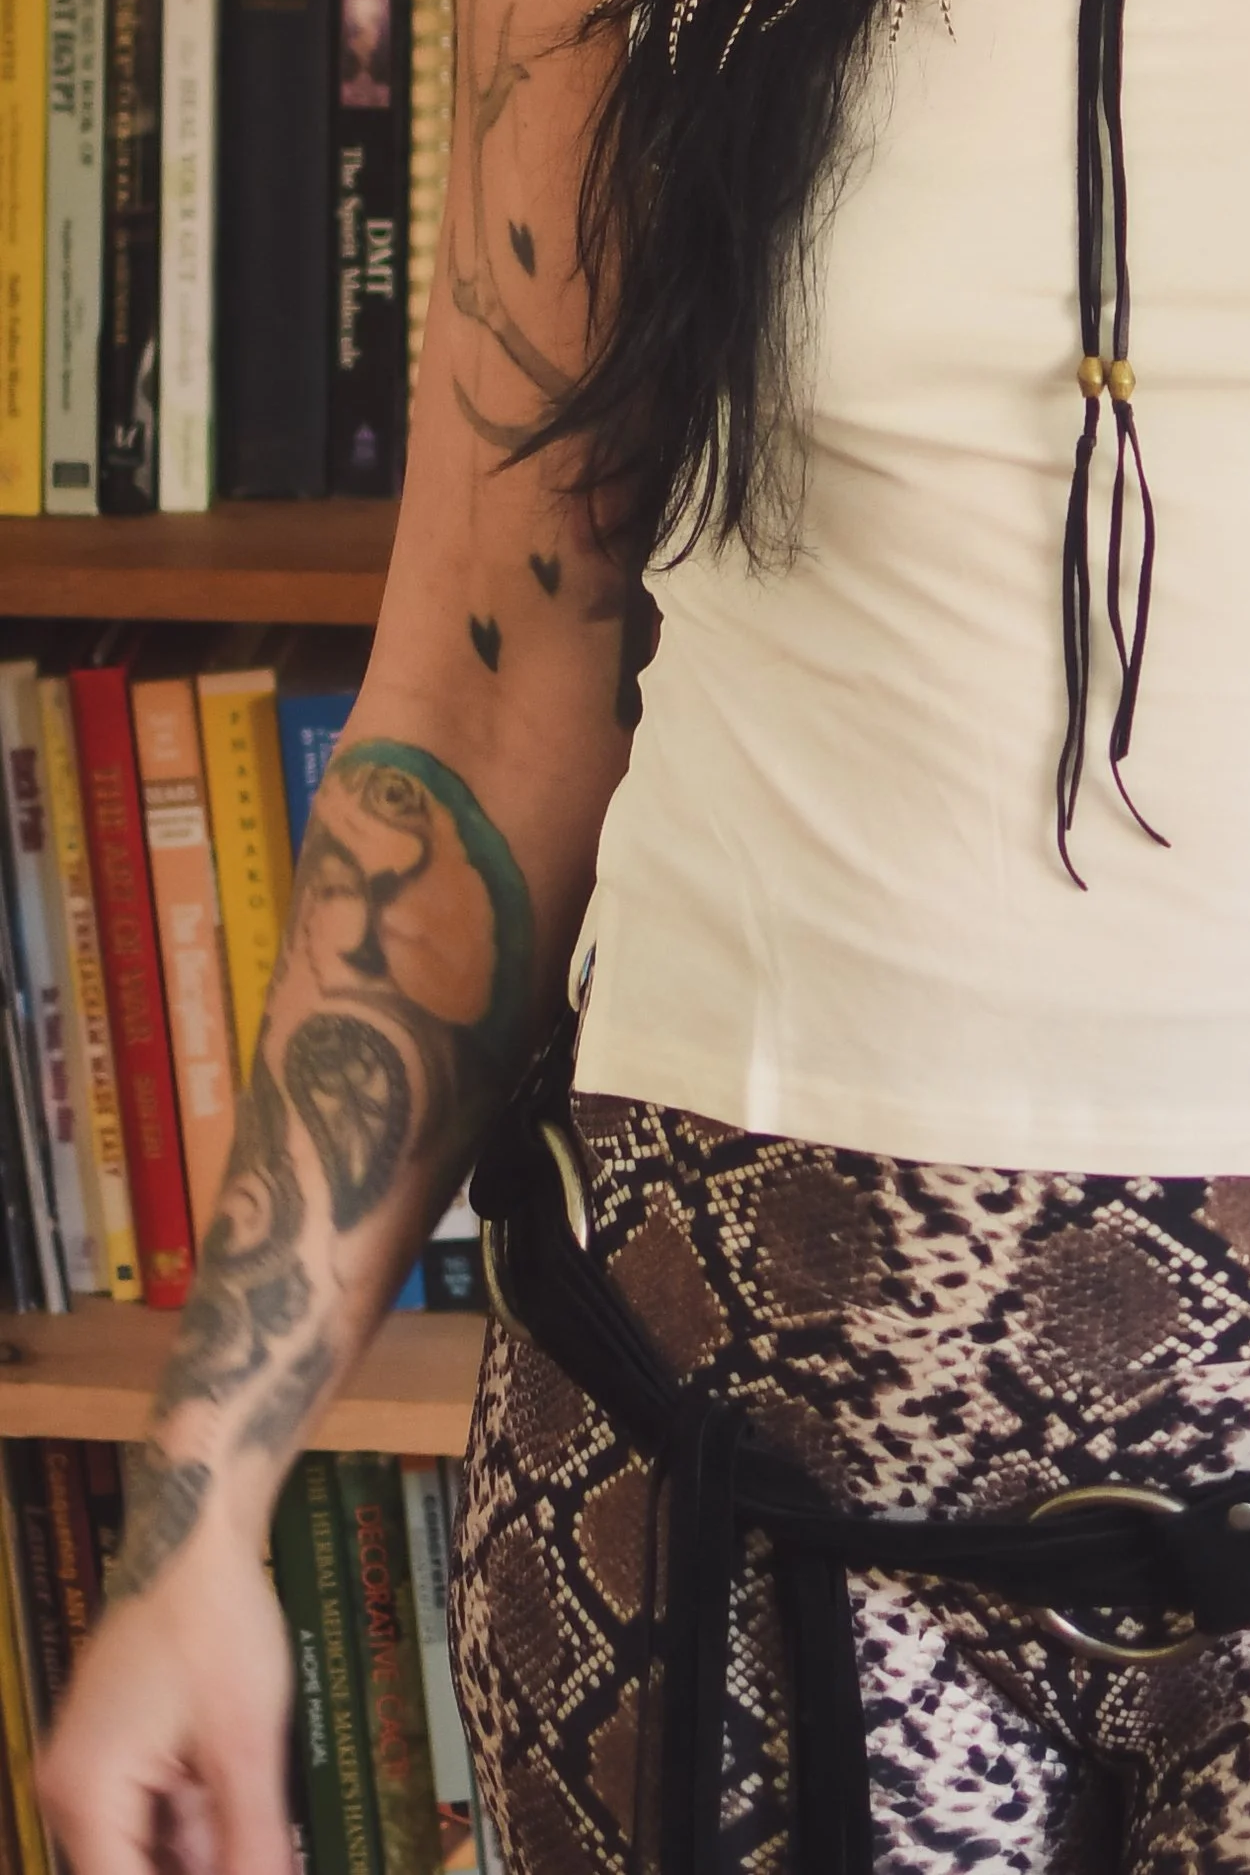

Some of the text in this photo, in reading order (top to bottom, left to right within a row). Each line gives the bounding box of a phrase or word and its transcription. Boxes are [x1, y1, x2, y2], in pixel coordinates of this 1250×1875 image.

[50, 29, 78, 118] EGYPT
[335, 146, 364, 371] The Spirit Molecule
[365, 217, 395, 300] DMT
[90, 765, 128, 835] THE
[101, 841, 136, 906] ART
[109, 916, 140, 957] OF
[115, 968, 154, 1046] WAR
[170, 903, 224, 1117] The Discipline Book
[46, 1454, 86, 1581] Conquering
[423, 1494, 448, 1612] concrete
[306, 1466, 368, 1801] THE HERBAL MEDICINE MAKER'S
[354, 1504, 410, 1780] DECORATIVE CACTI
[299, 1628, 330, 1768] A HOME MANUAL
